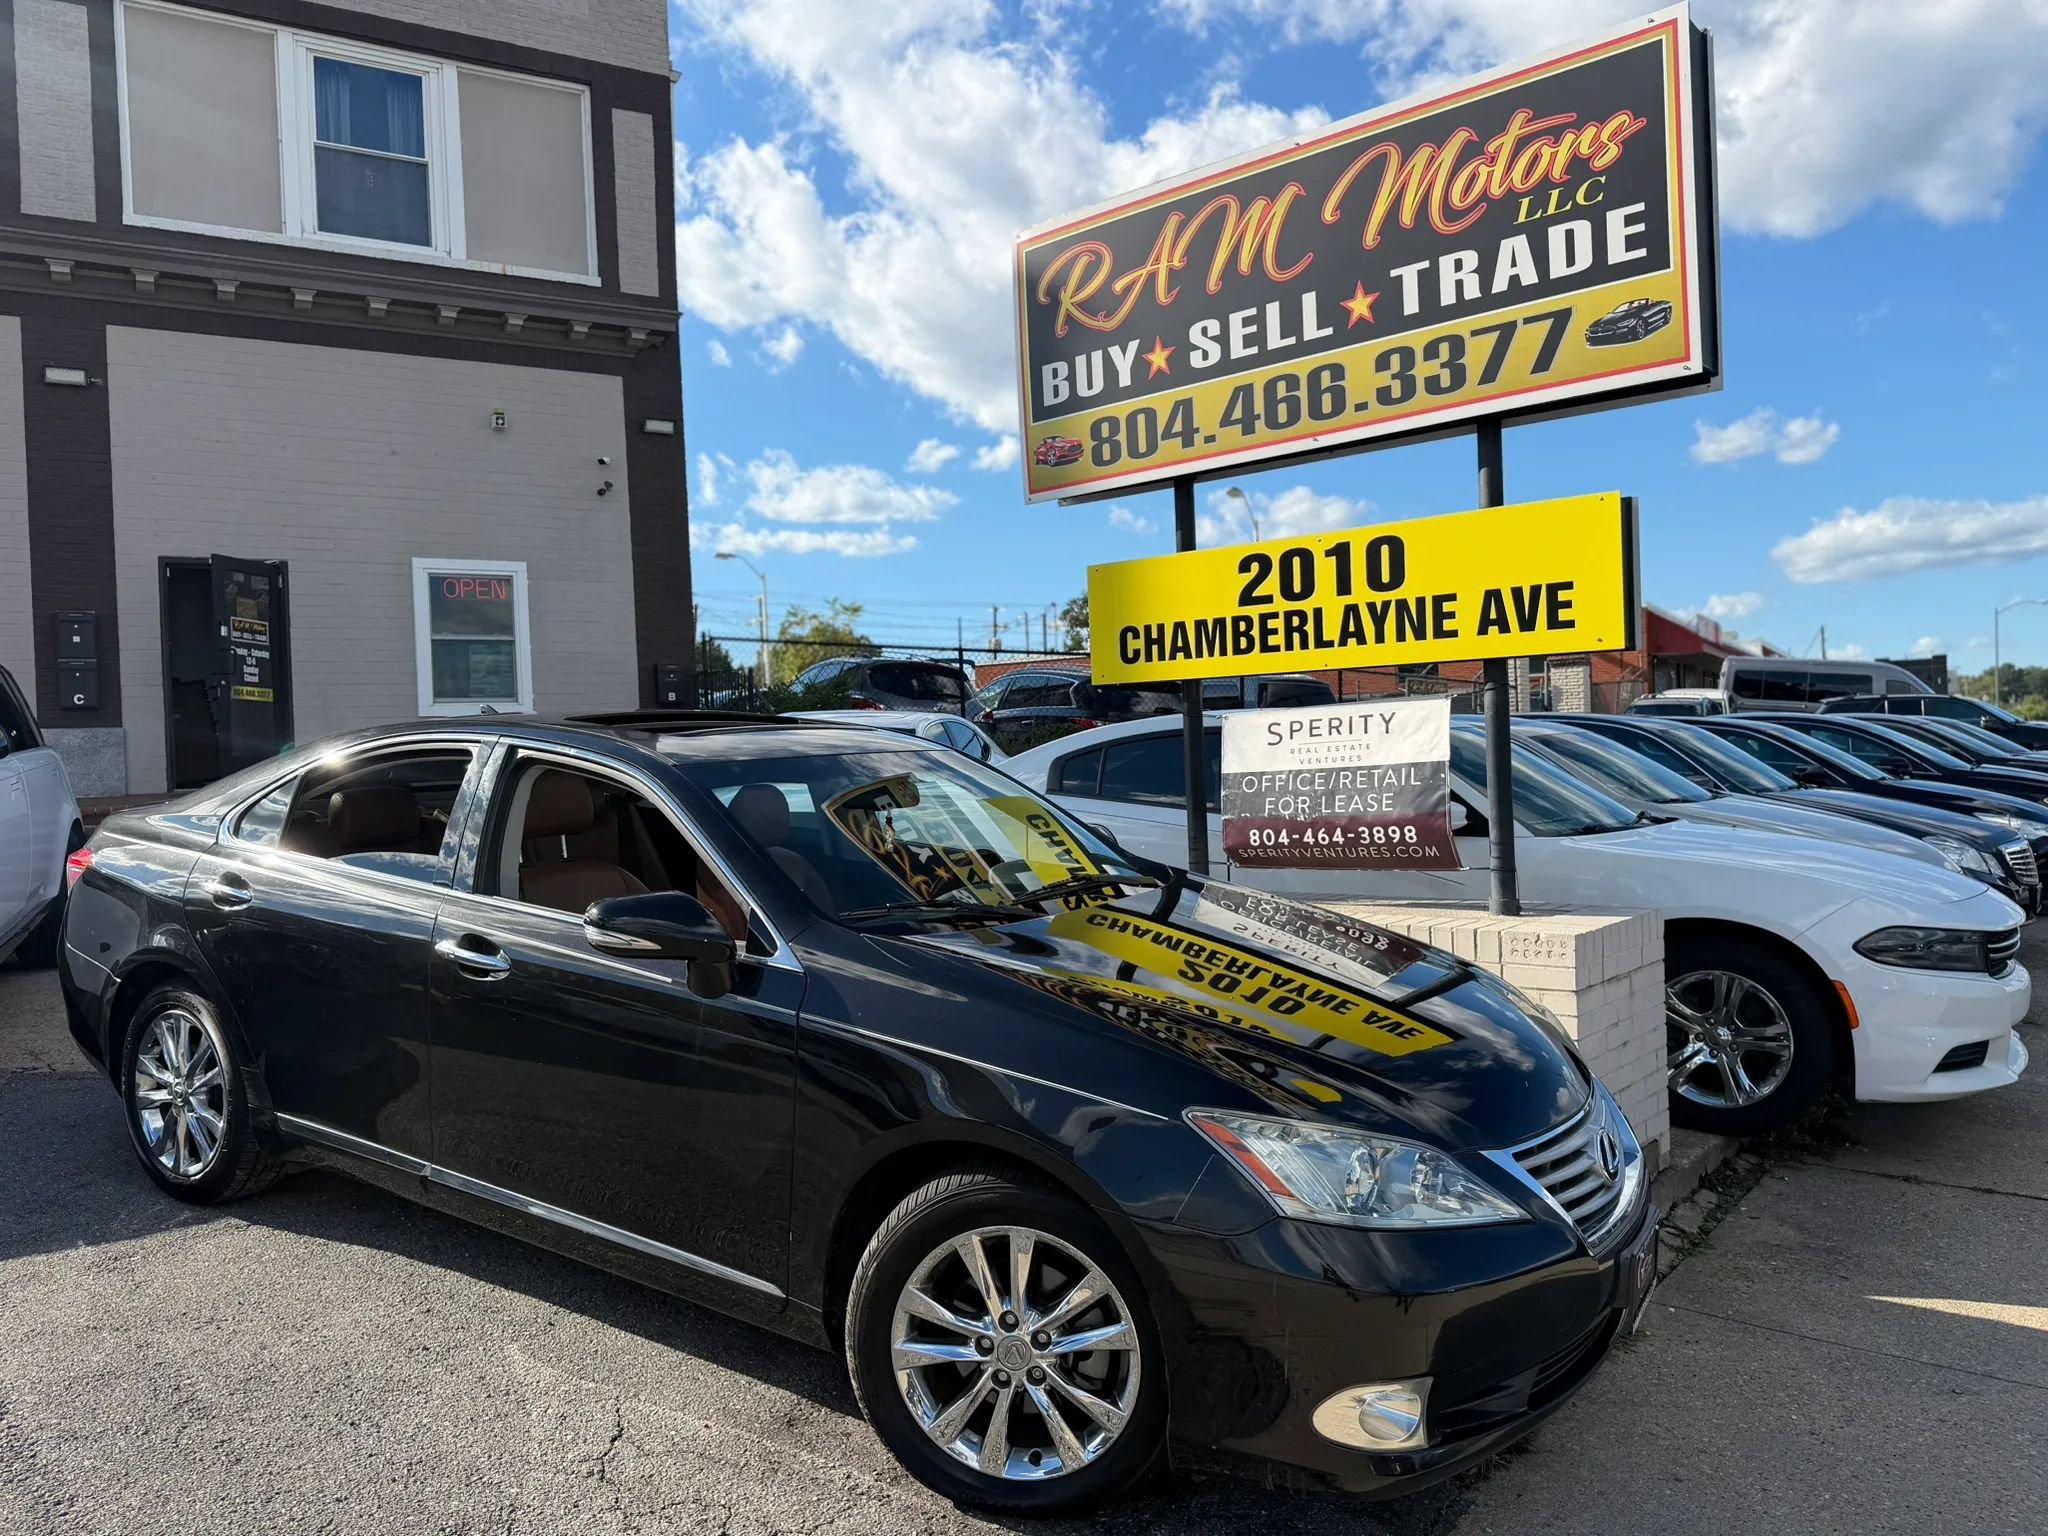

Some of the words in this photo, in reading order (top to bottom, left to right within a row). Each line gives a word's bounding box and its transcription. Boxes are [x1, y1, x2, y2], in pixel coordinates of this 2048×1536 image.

[1513, 176, 1606, 226] LLC
[1037, 181, 1313, 338] RAM
[1321, 108, 1646, 249] Motors
[1041, 339, 1140, 407] BUY
[1188, 291, 1333, 369] SELL
[1390, 202, 1647, 316] TRADE
[1090, 306, 1575, 467] 804.466.3377
[1238, 535, 1406, 608] 2010
[443, 578, 506, 600] OPEN
[1118, 592, 1459, 665] CHAMBERLAYNE
[1476, 581, 1576, 636] AVE
[73, 694, 85, 705] C
[668, 692, 676, 701] B
[1267, 711, 1396, 746] SPERITY
[1290, 746, 1320, 755] REAL
[1327, 743, 1372, 752] ESTATE
[1299, 755, 1362, 765] VENTURES
[1242, 766, 1421, 793] OFFICE/RETAIL
[1265, 796, 1310, 815] FOR
[1321, 793, 1394, 813] LEASE
[1249, 825, 1418, 846] 804-464-3898
[1238, 845, 1440, 858] SPERITYVENTURES.COM
